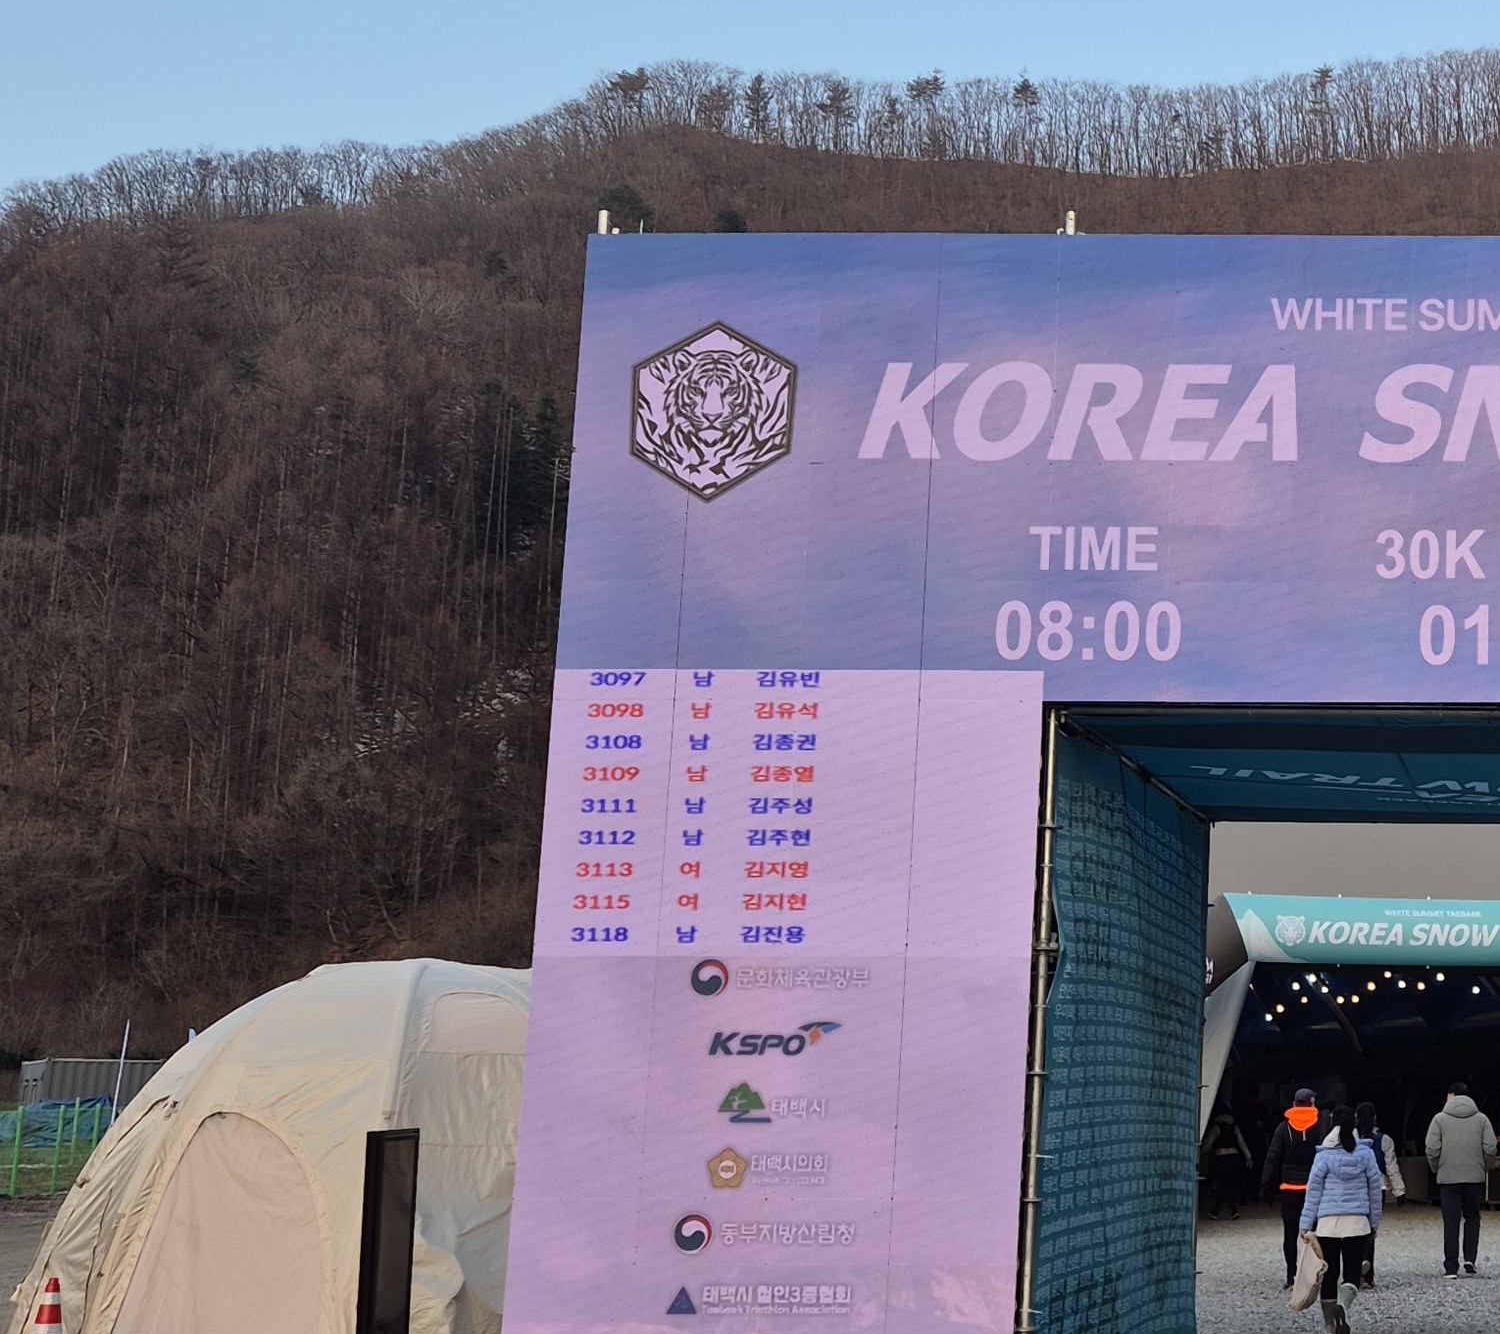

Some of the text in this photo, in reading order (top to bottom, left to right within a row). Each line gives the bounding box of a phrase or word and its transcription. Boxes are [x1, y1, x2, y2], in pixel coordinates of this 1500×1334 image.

[1272, 298, 1408, 332] WHITE
[858, 361, 1298, 462] KOREA
[1029, 526, 1159, 572] TIME
[1376, 530, 1486, 580] 30K
[995, 600, 1182, 662] 08:00
[590, 671, 820, 688] 3097 남 김유빈
[587, 702, 818, 719] 3098 남 김유석
[585, 734, 642, 750] 3108
[688, 733, 711, 751] 남
[582, 766, 640, 782] 3109
[686, 765, 708, 783] 남
[1189, 765, 1404, 787] TRAIL
[580, 797, 813, 815] 3111 남 김주성
[578, 829, 811, 847] 3112 남 김주현
[575, 861, 809, 879] 3113 여 김지영
[573, 893, 808, 911] 3115 여 김지현
[570, 925, 806, 944] 3118 남 김진용
[1308, 921, 1403, 946] KOREA
[1408, 923, 1500, 947] SNOW
[735, 968, 870, 988] 문화체육관광부
[708, 1031, 806, 1056] KSPO
[771, 1098, 826, 1118] 태백시
[750, 1154, 829, 1172] 태백시의회
[721, 1223, 855, 1245] 동부지방산림청
[702, 1285, 753, 1304] 태백시
